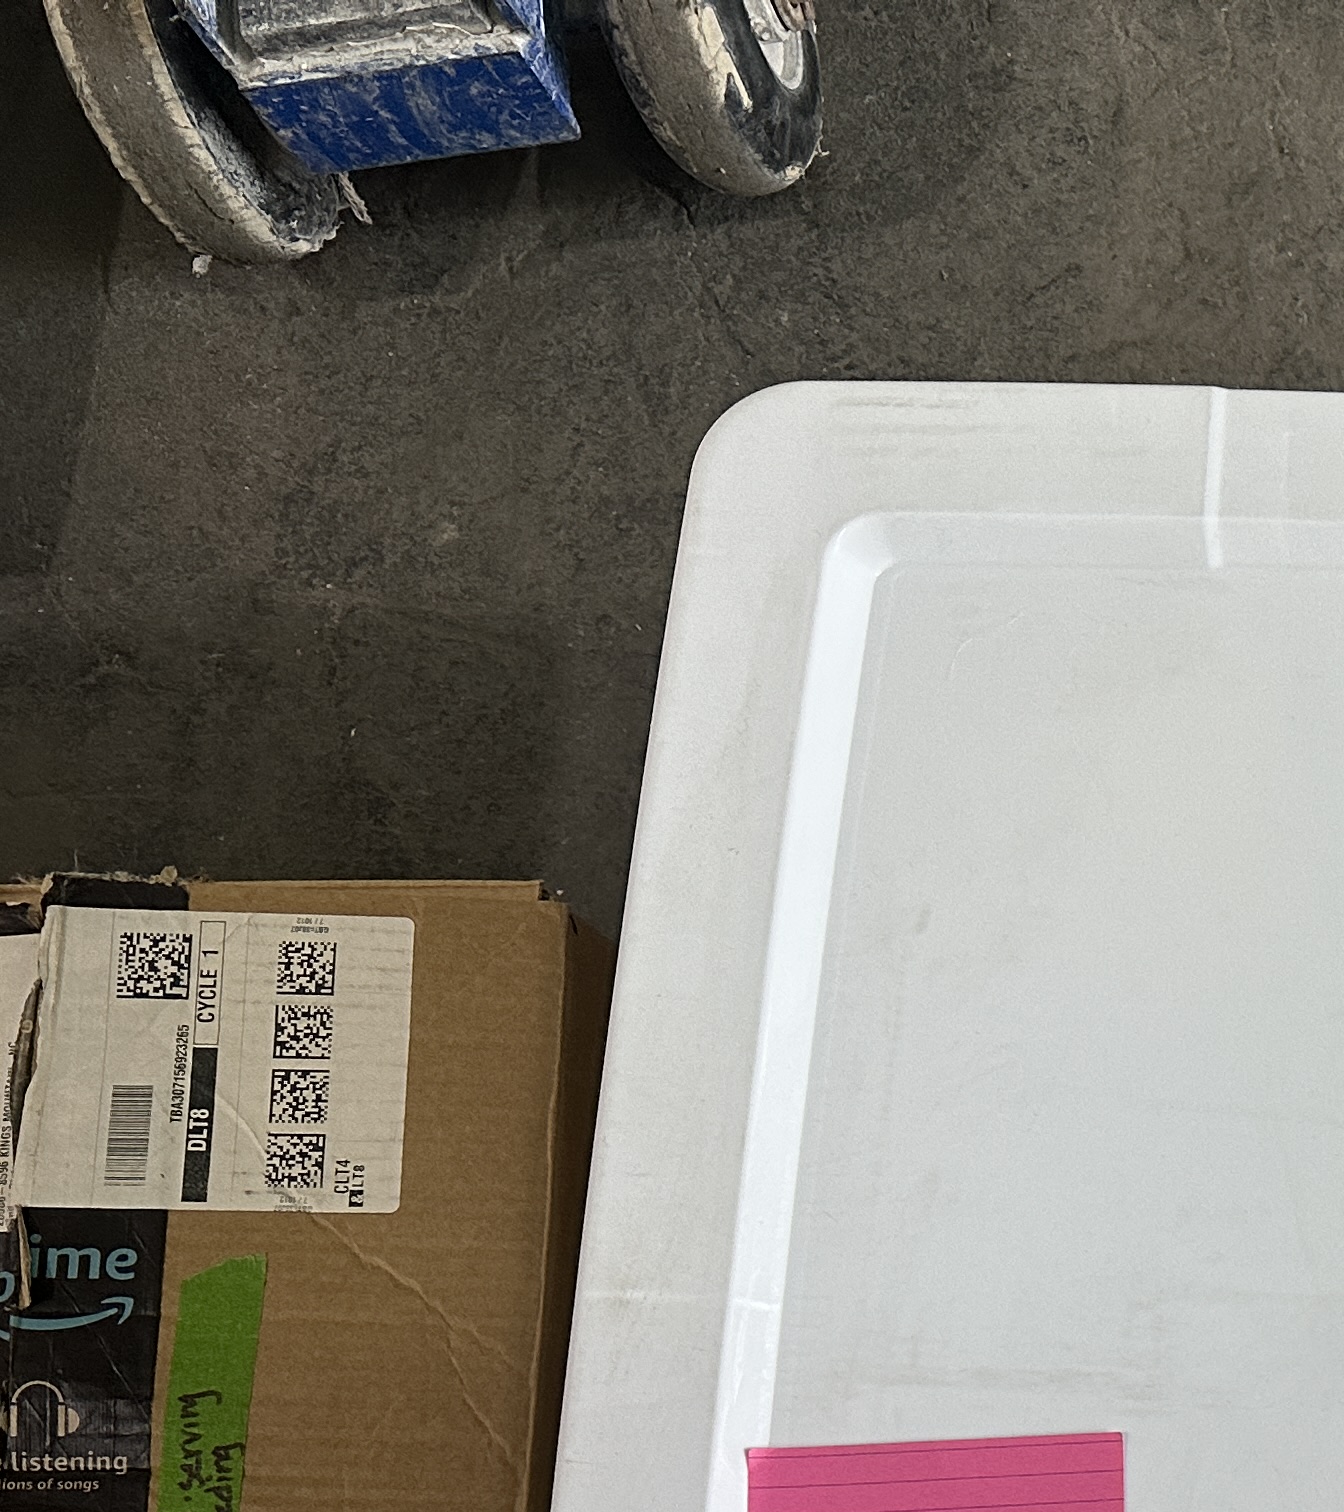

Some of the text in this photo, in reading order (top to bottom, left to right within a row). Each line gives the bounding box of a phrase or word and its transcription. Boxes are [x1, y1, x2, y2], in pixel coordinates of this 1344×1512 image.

[197, 948, 219, 1023] CYCLE 1
[187, 1108, 209, 1151] DLT8
[334, 1159, 350, 1193] CLT4
[10, 1450, 127, 1474] listening
[37, 1478, 98, 1492] of songs
